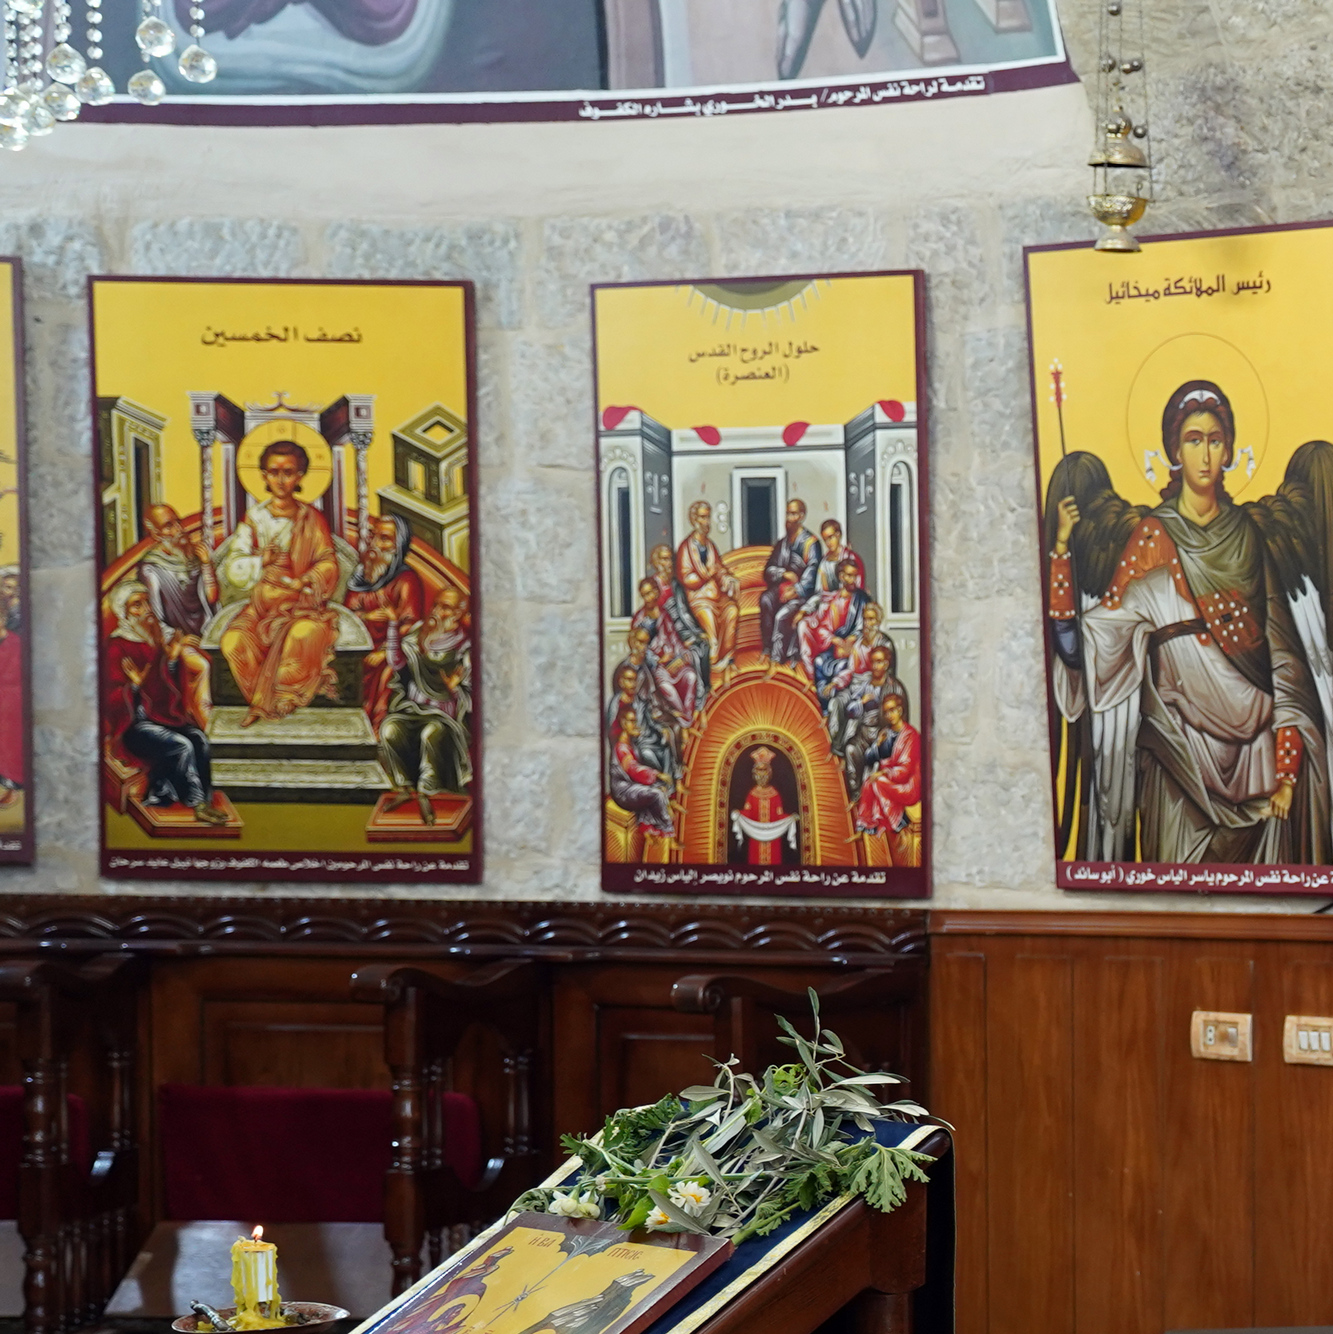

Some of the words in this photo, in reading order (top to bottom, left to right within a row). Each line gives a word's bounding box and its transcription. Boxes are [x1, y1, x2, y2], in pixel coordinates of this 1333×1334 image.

[872, 83, 902, 101] نفس
[940, 76, 986, 93] تقدمة
[1163, 274, 1226, 298] الملائكة
[1231, 270, 1271, 295] رئيس
[1105, 280, 1161, 304] ميخائيل
[201, 325, 299, 348] الخمسين
[304, 325, 363, 343] نصف
[688, 343, 737, 363] القدس
[739, 341, 779, 363] الروح
[782, 341, 820, 359] حلول
[734, 870, 774, 885] المرحوم
[775, 870, 800, 885] نفس
[802, 870, 831, 886] راحة
[831, 872, 849, 886] عن
[850, 870, 886, 884] تقدمة
[1125, 867, 1156, 885] خوري
[1188, 869, 1215, 886] ياسر
[1215, 869, 1254, 886] المرحوم
[1255, 870, 1281, 887] نفس
[1281, 870, 1311, 887] راحة
[1311, 873, 1329, 888] عن
